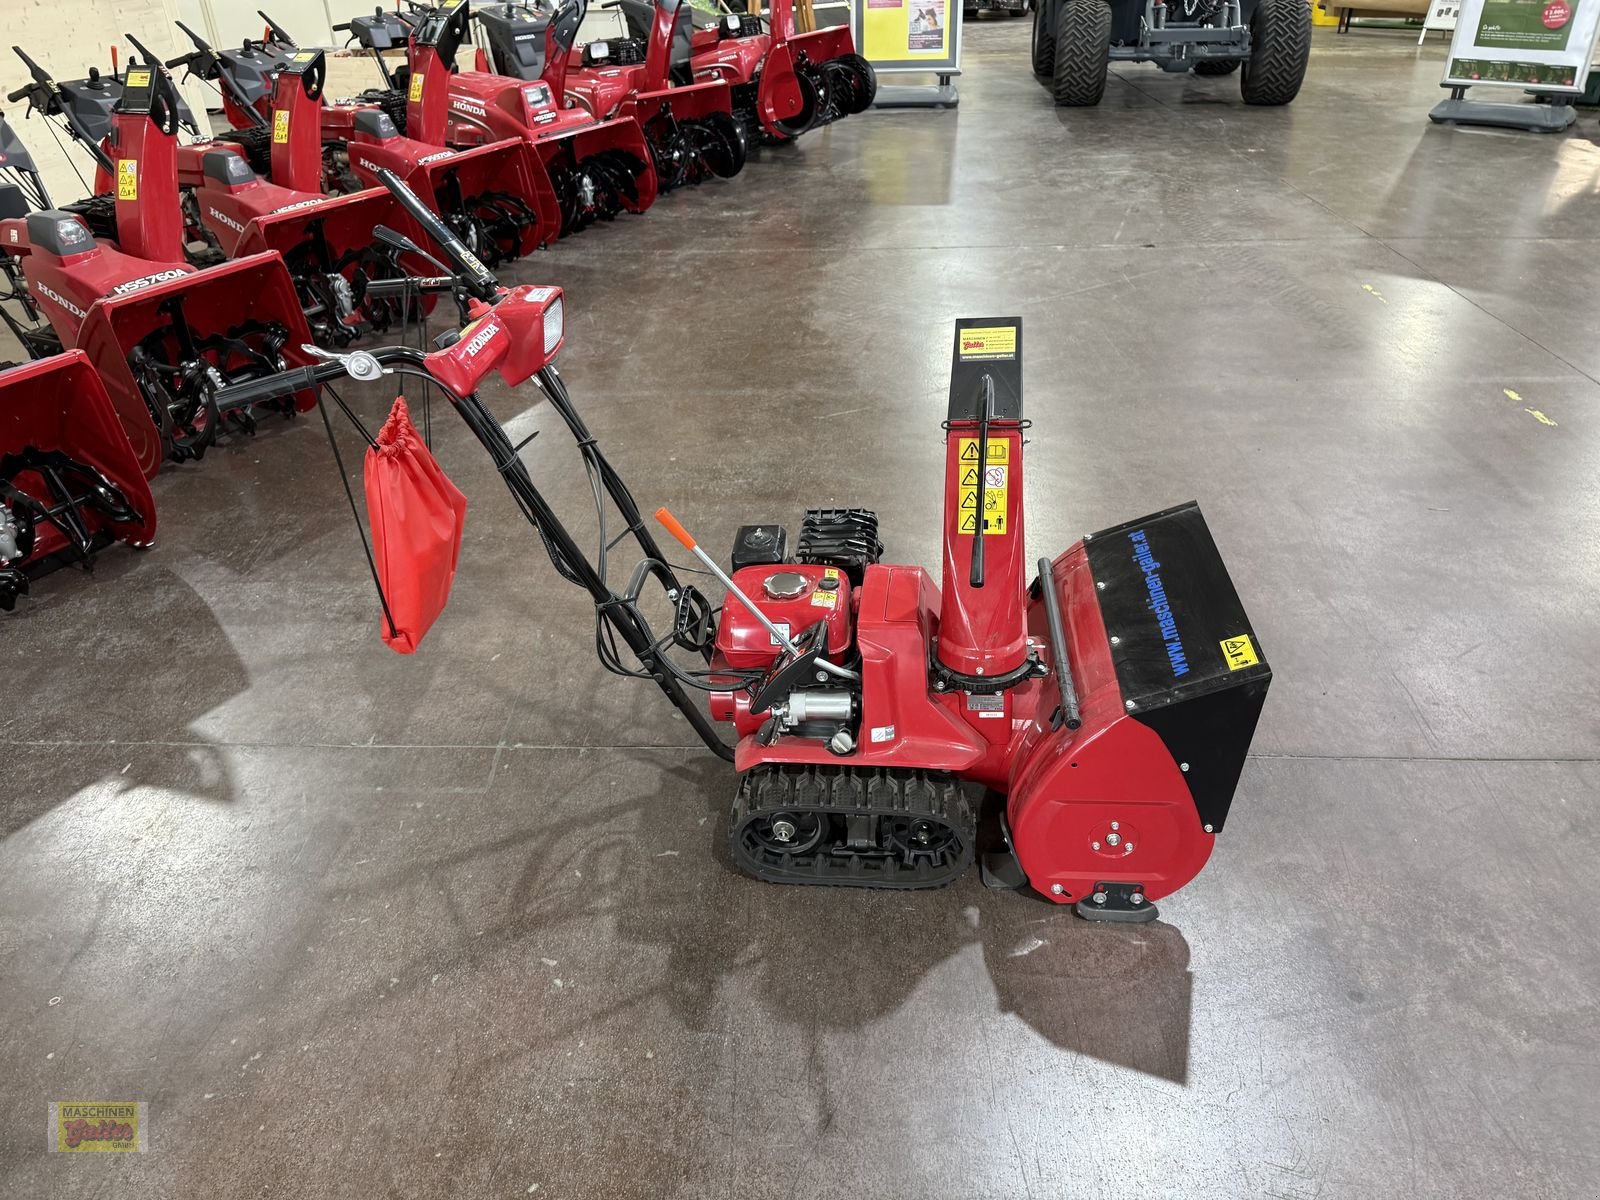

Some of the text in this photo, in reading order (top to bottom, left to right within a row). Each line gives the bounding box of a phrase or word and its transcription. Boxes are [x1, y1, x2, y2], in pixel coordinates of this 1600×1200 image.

[453, 101, 487, 117] HONDA
[114, 269, 188, 294] HSS760A
[466, 323, 500, 357] HONDA
[1128, 529, 1190, 677] www.maschinen-gailer.at
